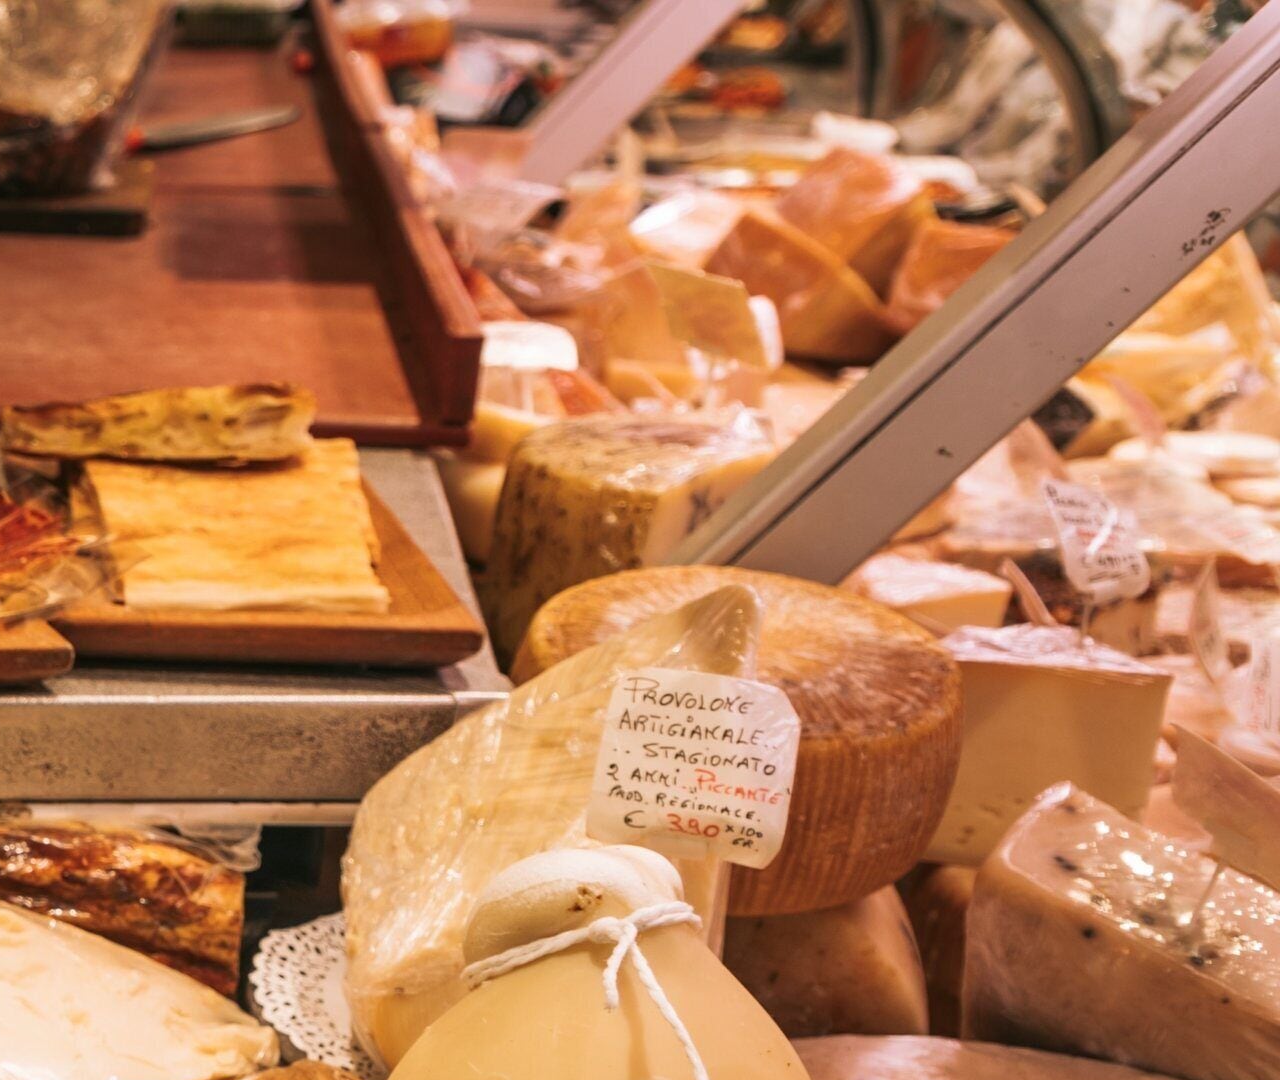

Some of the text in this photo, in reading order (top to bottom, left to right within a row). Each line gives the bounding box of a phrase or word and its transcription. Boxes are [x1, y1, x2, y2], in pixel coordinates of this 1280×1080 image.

[623, 676, 755, 715] PROVOLONE
[606, 763, 620, 782] 2
[693, 767, 784, 806] PICCANTE
[623, 810, 647, 829] €
